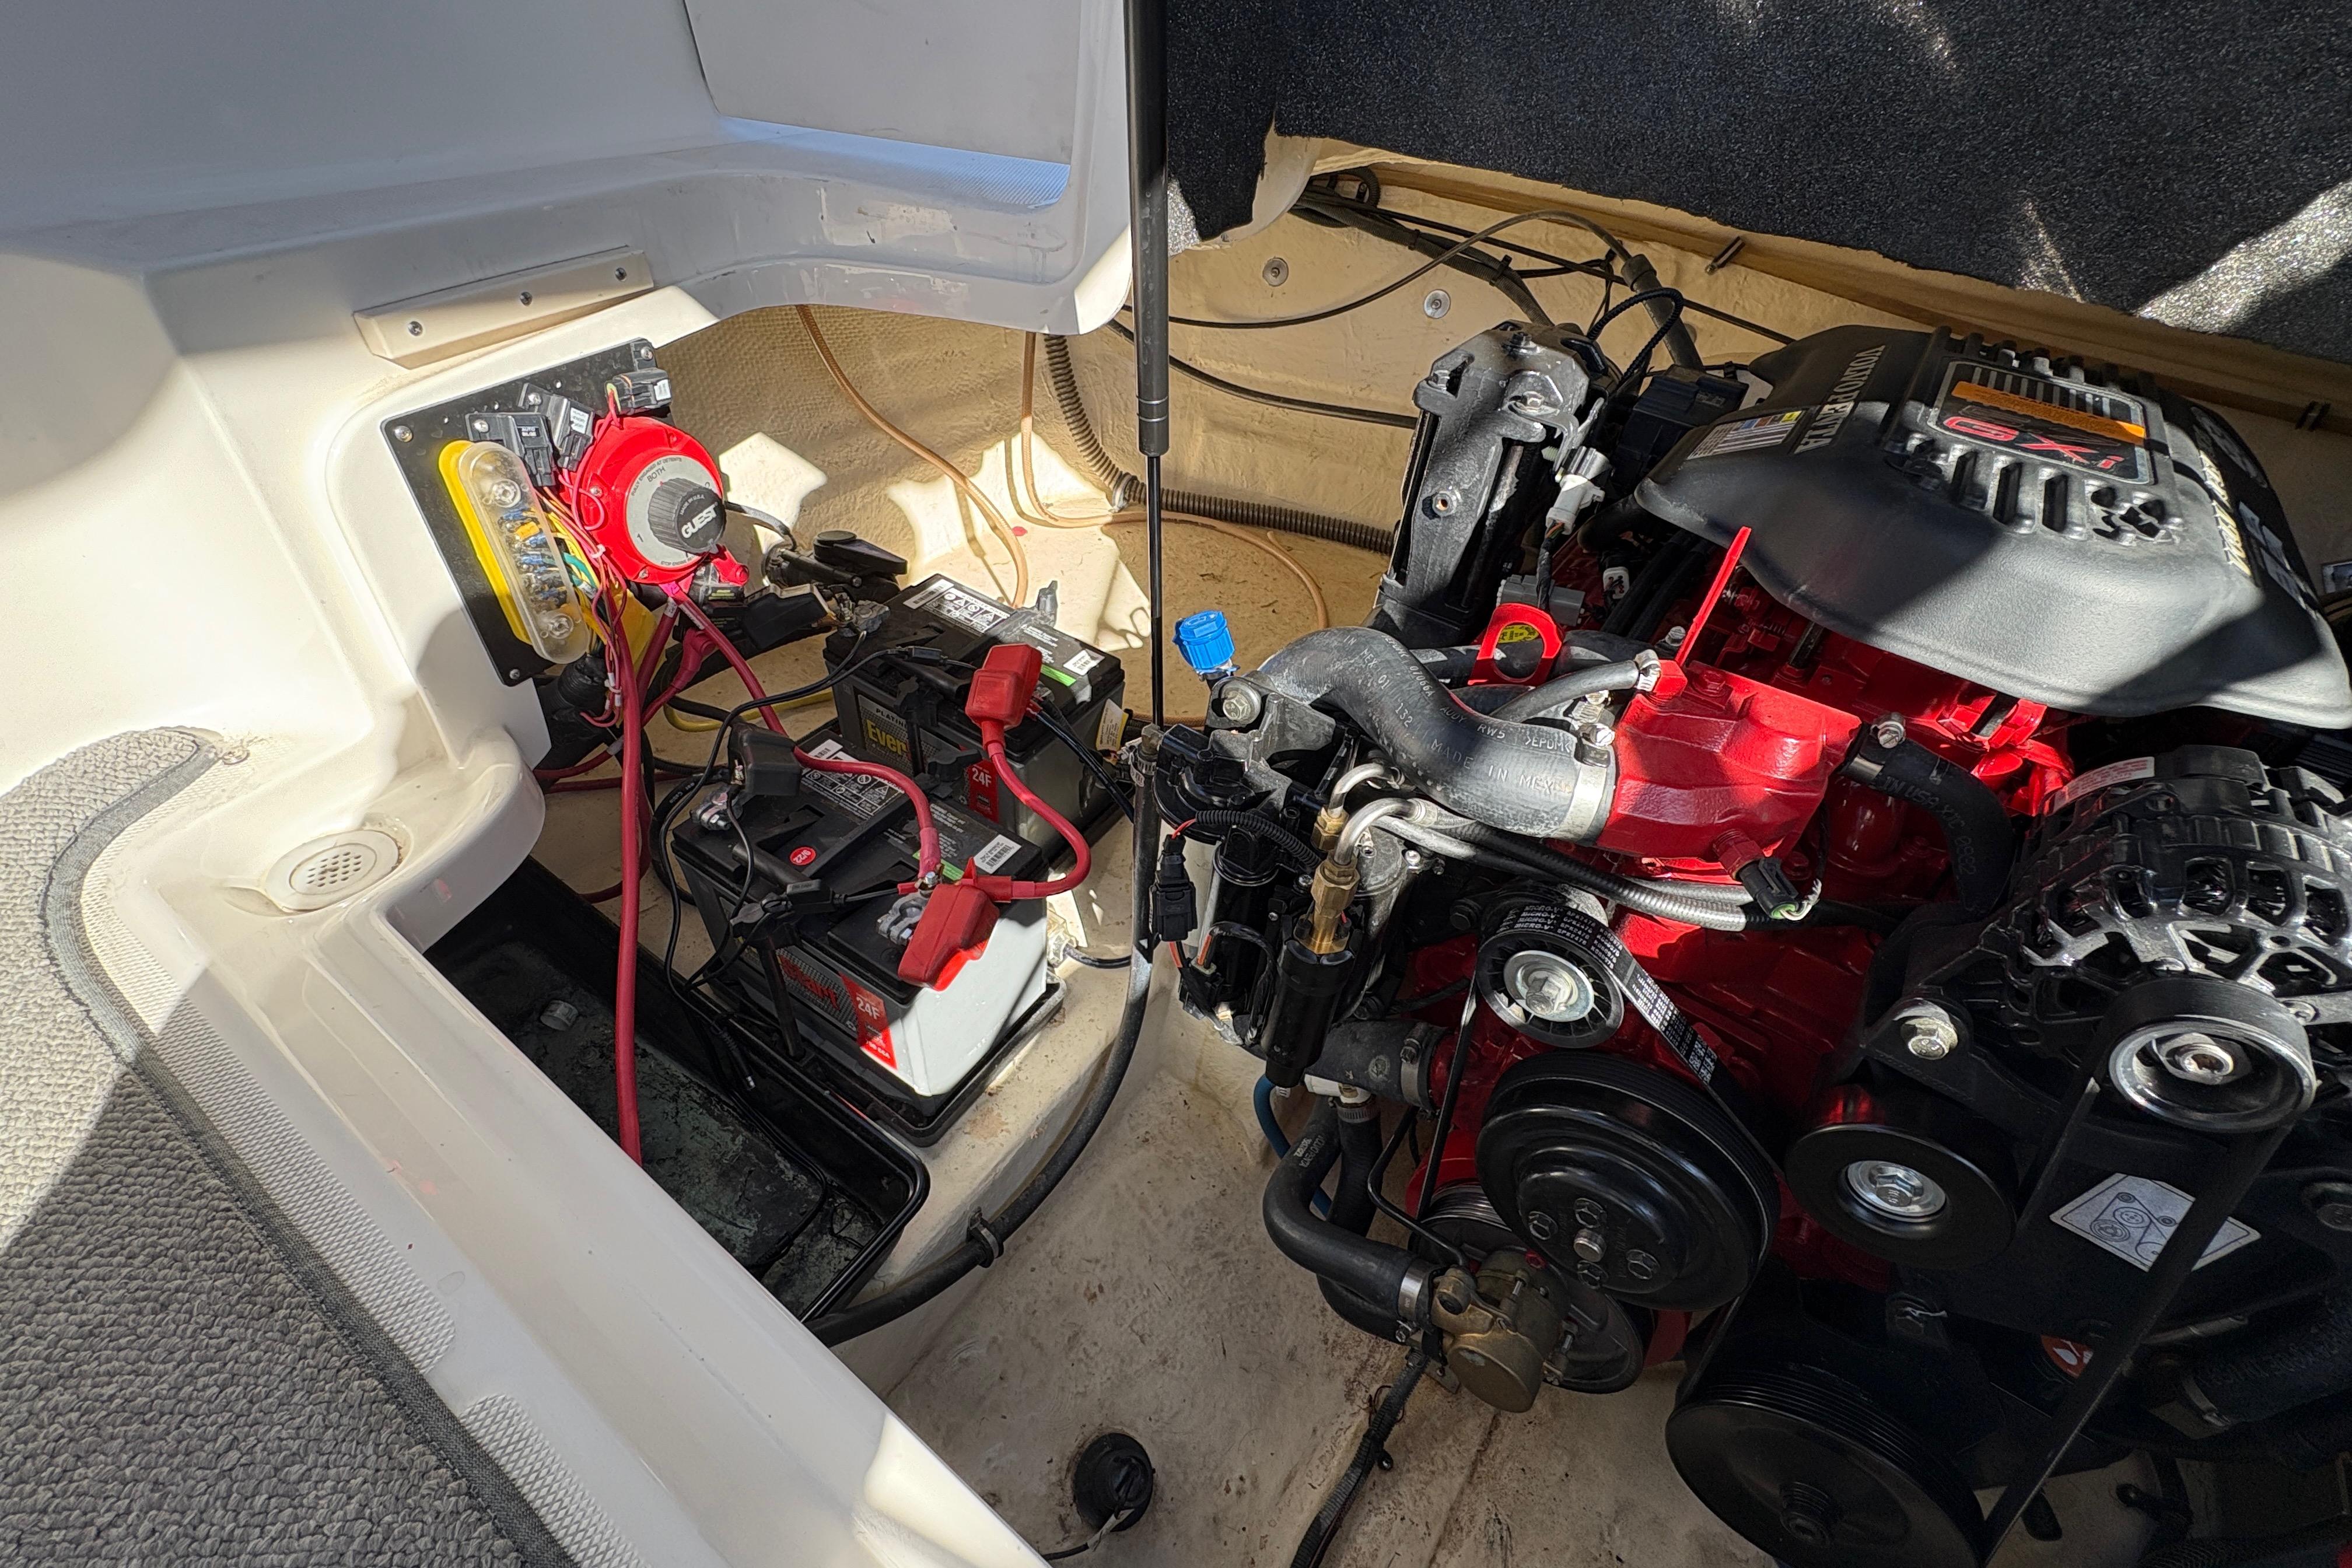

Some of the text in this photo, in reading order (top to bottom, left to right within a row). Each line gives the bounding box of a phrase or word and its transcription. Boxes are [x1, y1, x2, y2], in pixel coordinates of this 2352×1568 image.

[1793, 345, 1885, 454] VOLVO PENTA
[647, 466, 666, 482] BOTH
[680, 501, 689, 515] MADE
[681, 504, 717, 538] GUEST
[637, 533, 643, 542] 1
[876, 708, 907, 729] PLATIN
[1395, 702, 1413, 728] 132
[1431, 738, 1474, 770] MADE
[1489, 765, 1508, 782] IN
[972, 767, 992, 788] 24F
[793, 849, 811, 863] 9/22
[856, 996, 880, 1020] 24F
